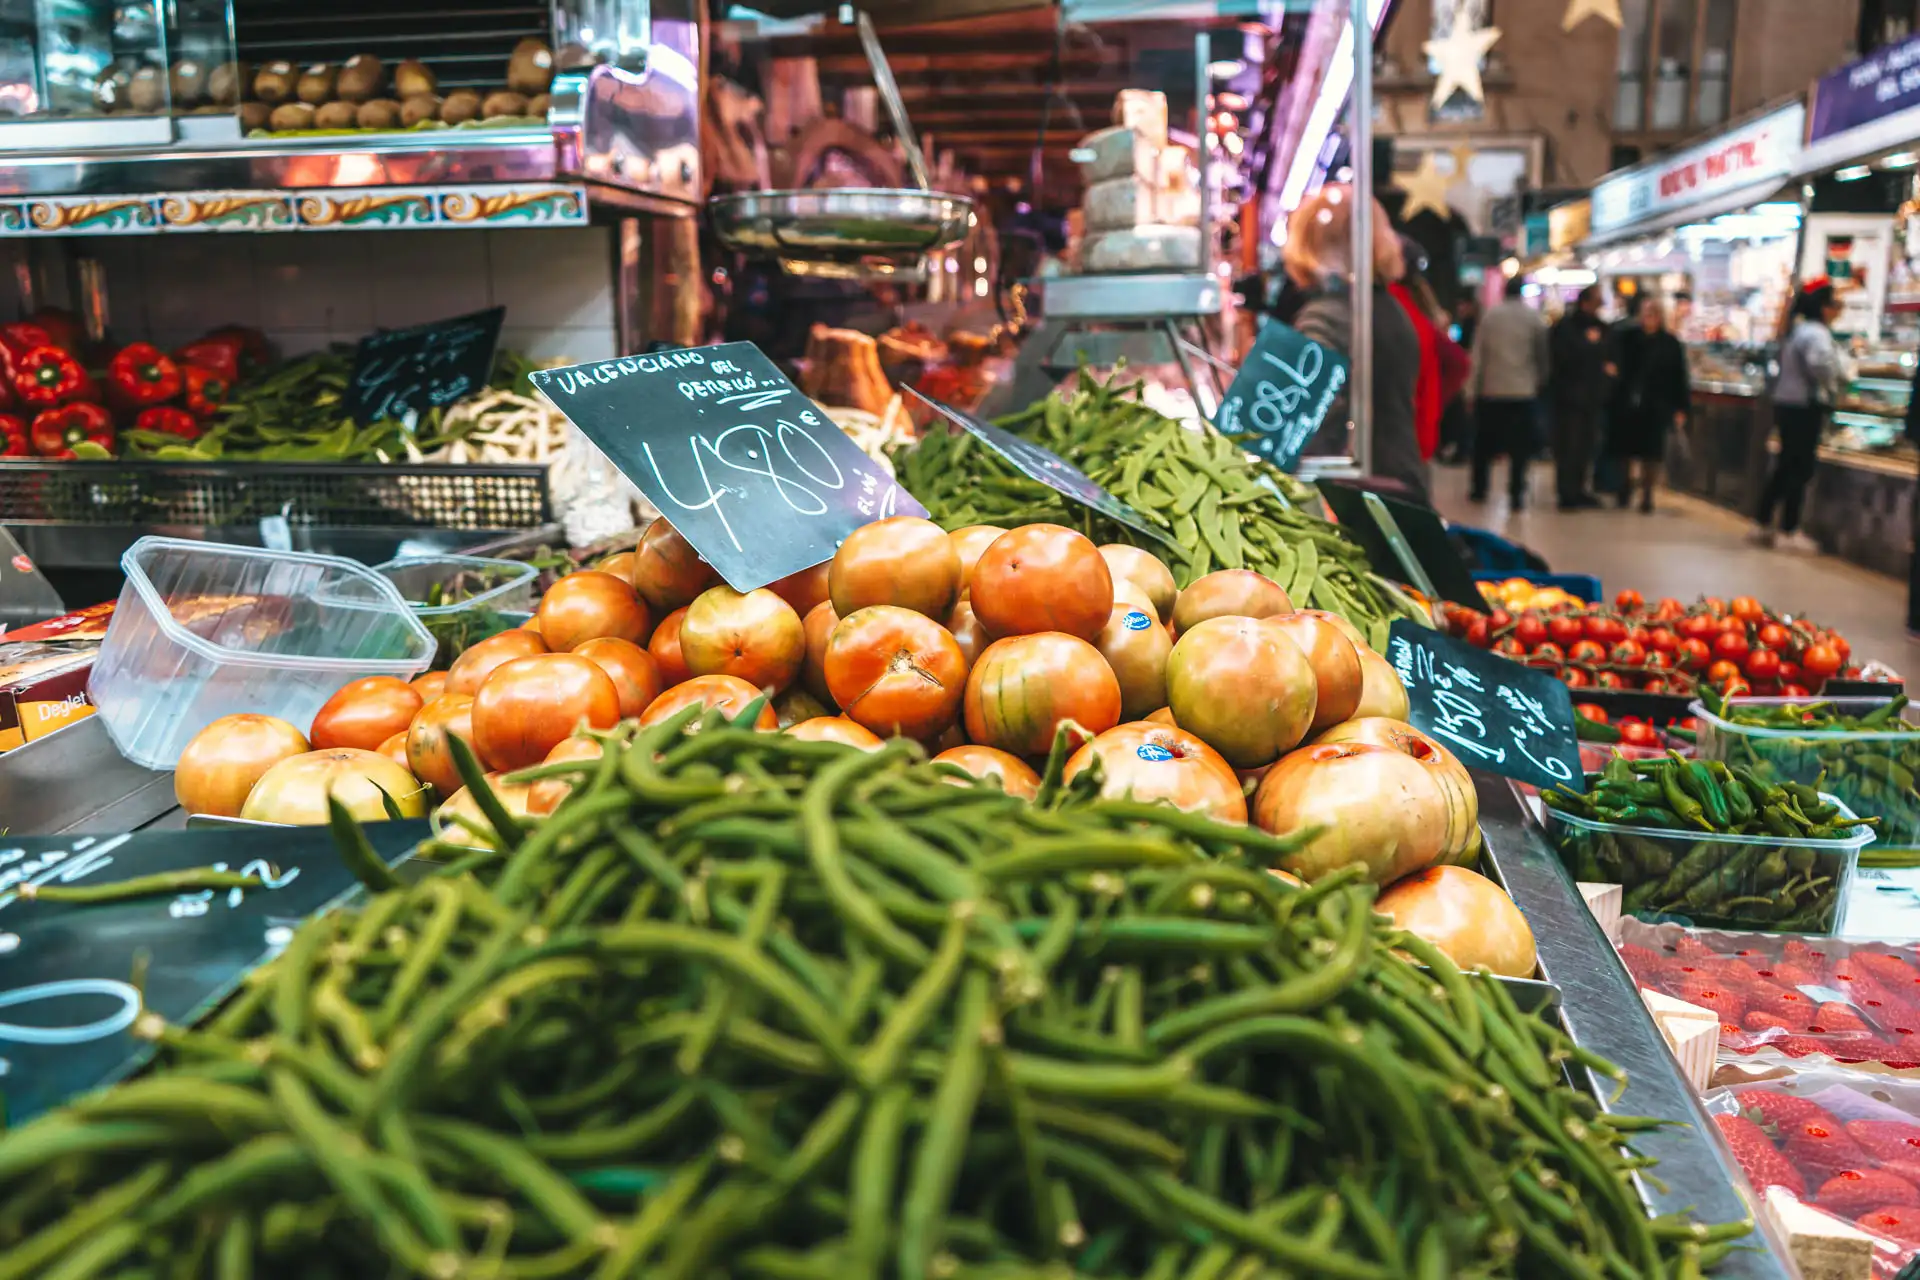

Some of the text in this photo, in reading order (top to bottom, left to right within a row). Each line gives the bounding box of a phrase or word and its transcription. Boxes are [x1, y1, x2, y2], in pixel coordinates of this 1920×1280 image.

[557, 351, 706, 395] VALENCIANO
[710, 359, 742, 375] DEL
[38, 690, 87, 721] Deglet
